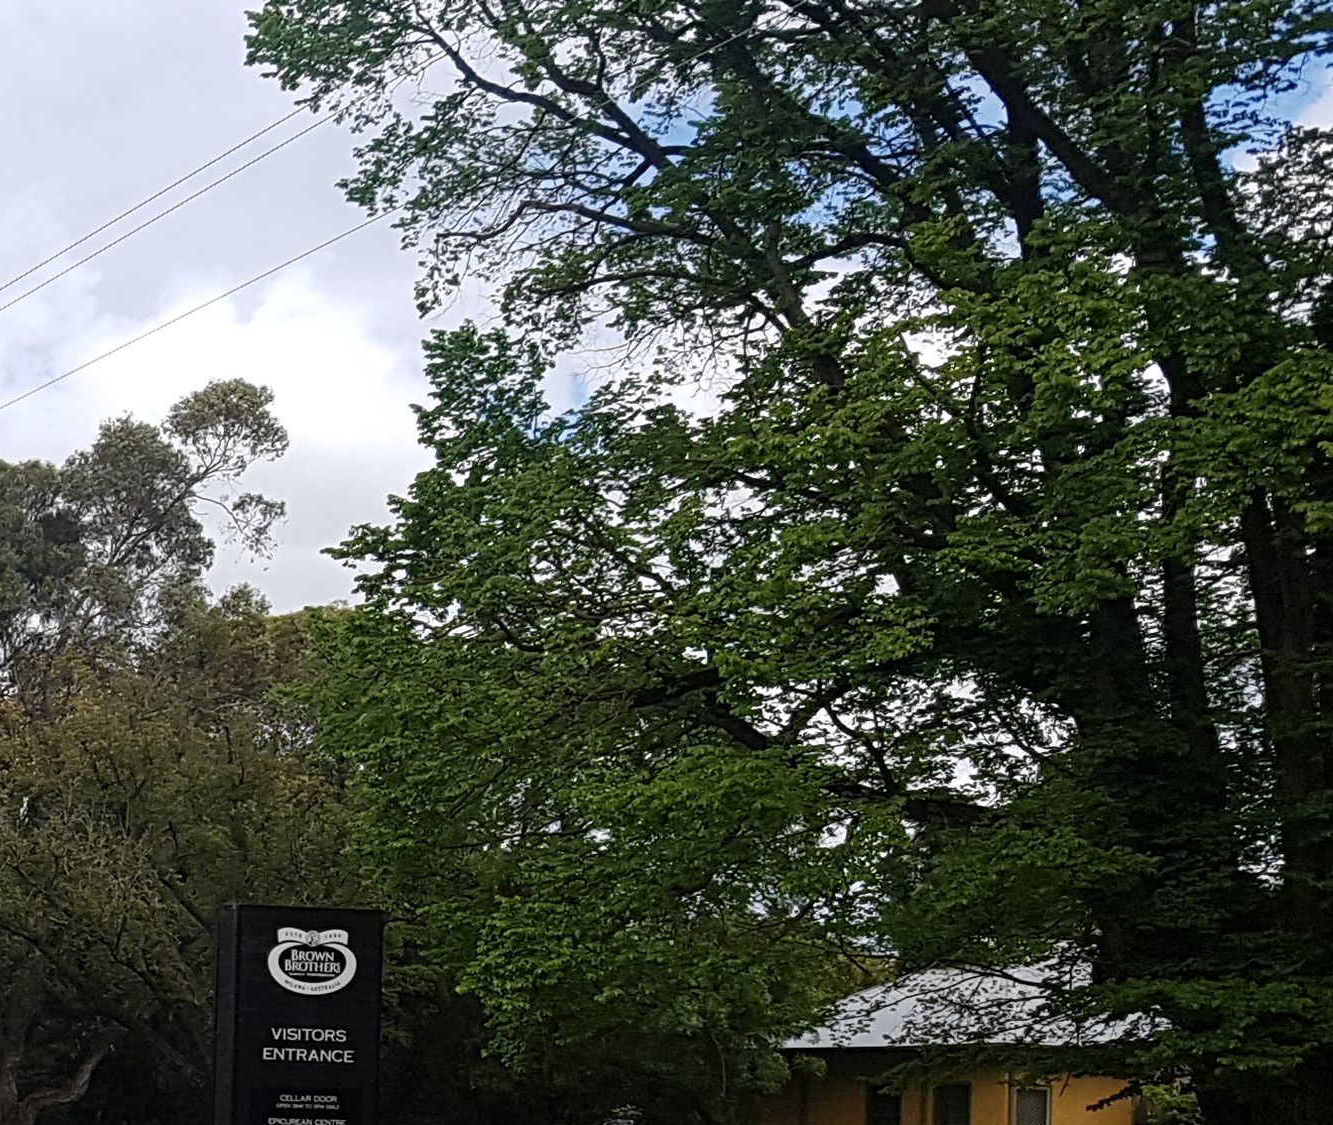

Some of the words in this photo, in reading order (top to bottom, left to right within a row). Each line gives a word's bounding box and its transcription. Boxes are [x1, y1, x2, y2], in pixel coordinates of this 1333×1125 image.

[291, 949, 334, 962] BROWN
[284, 959, 341, 974] BROTHERS
[271, 1028, 347, 1042] VISITORS
[262, 1048, 354, 1063] ENTRANCE
[280, 1094, 311, 1102] CELLAR
[314, 1095, 337, 1103] DOOR
[268, 1117, 312, 1125] EPICUREAN
